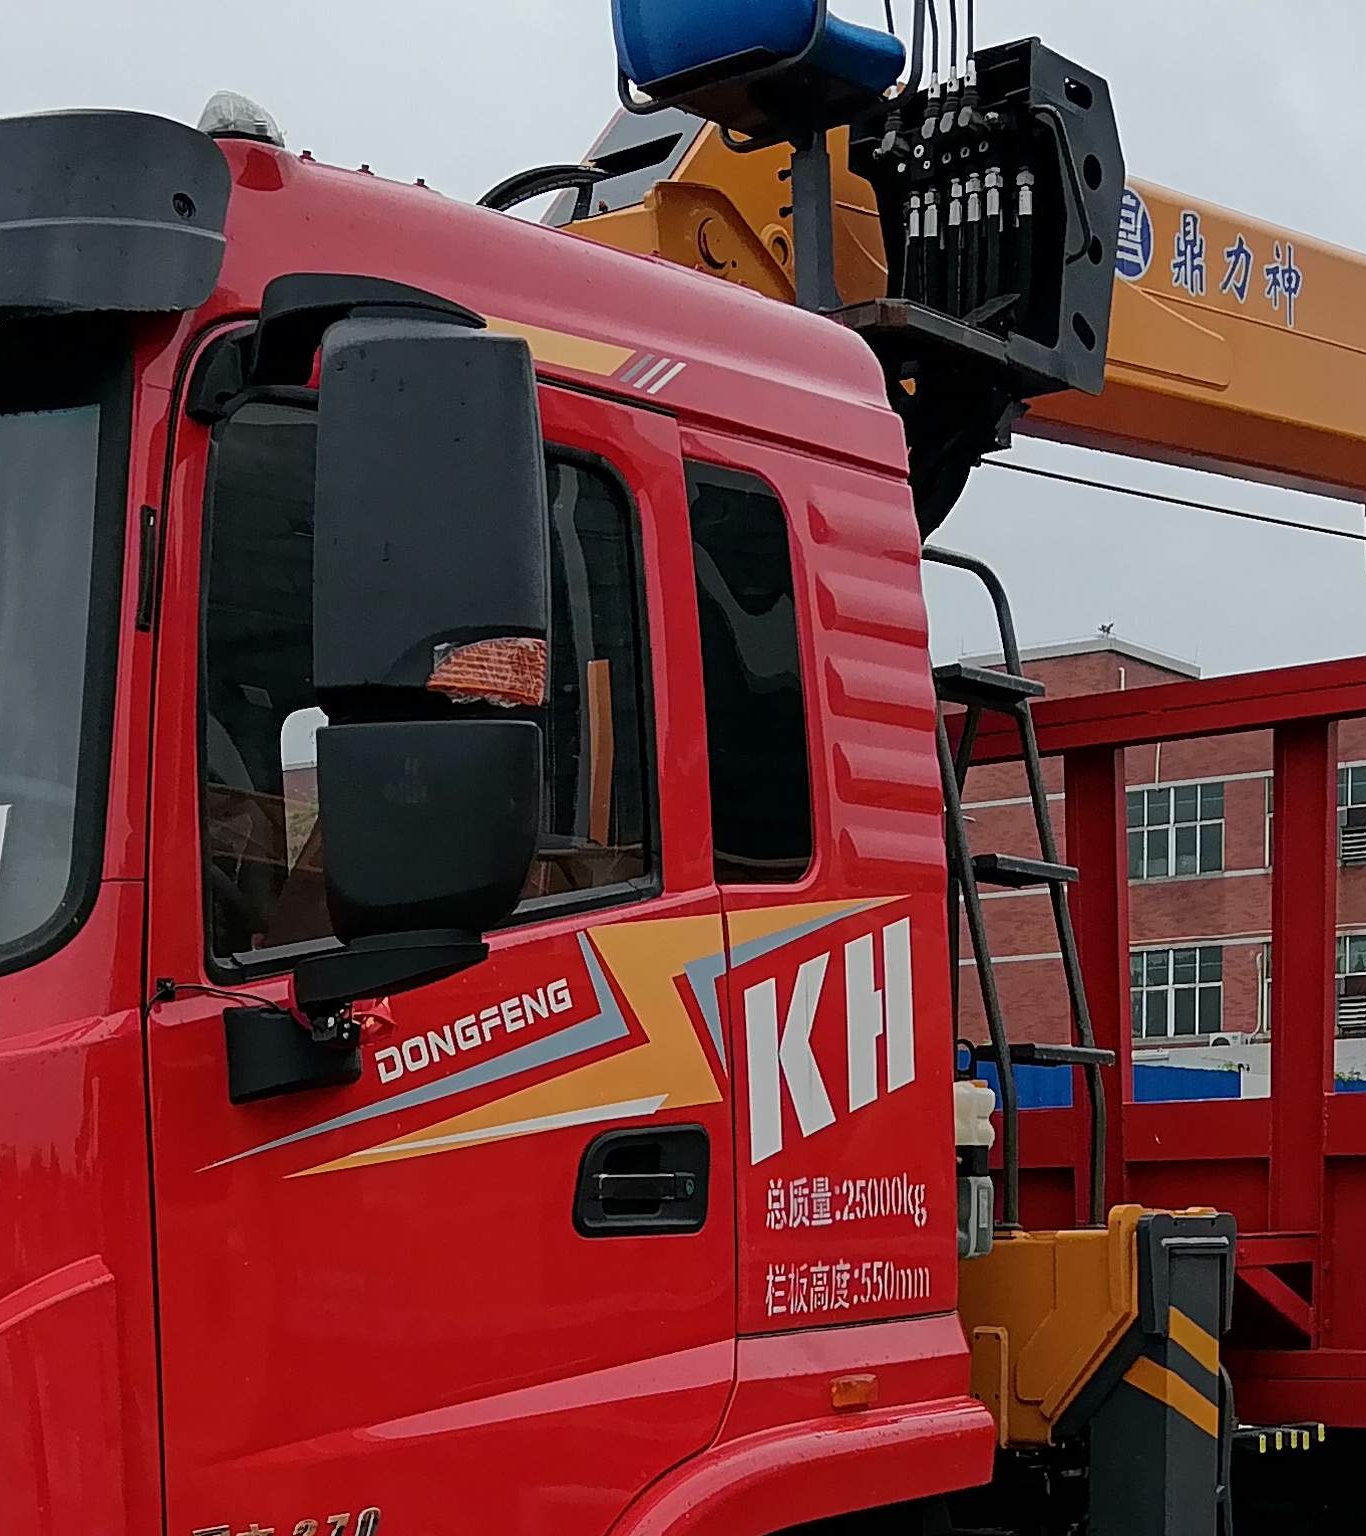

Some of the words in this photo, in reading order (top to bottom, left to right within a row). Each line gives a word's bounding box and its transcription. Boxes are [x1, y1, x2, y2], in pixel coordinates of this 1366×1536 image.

[1171, 210, 1304, 329] 鼎力神
[374, 977, 573, 1085] DONGFENG
[742, 915, 916, 1166] KH
